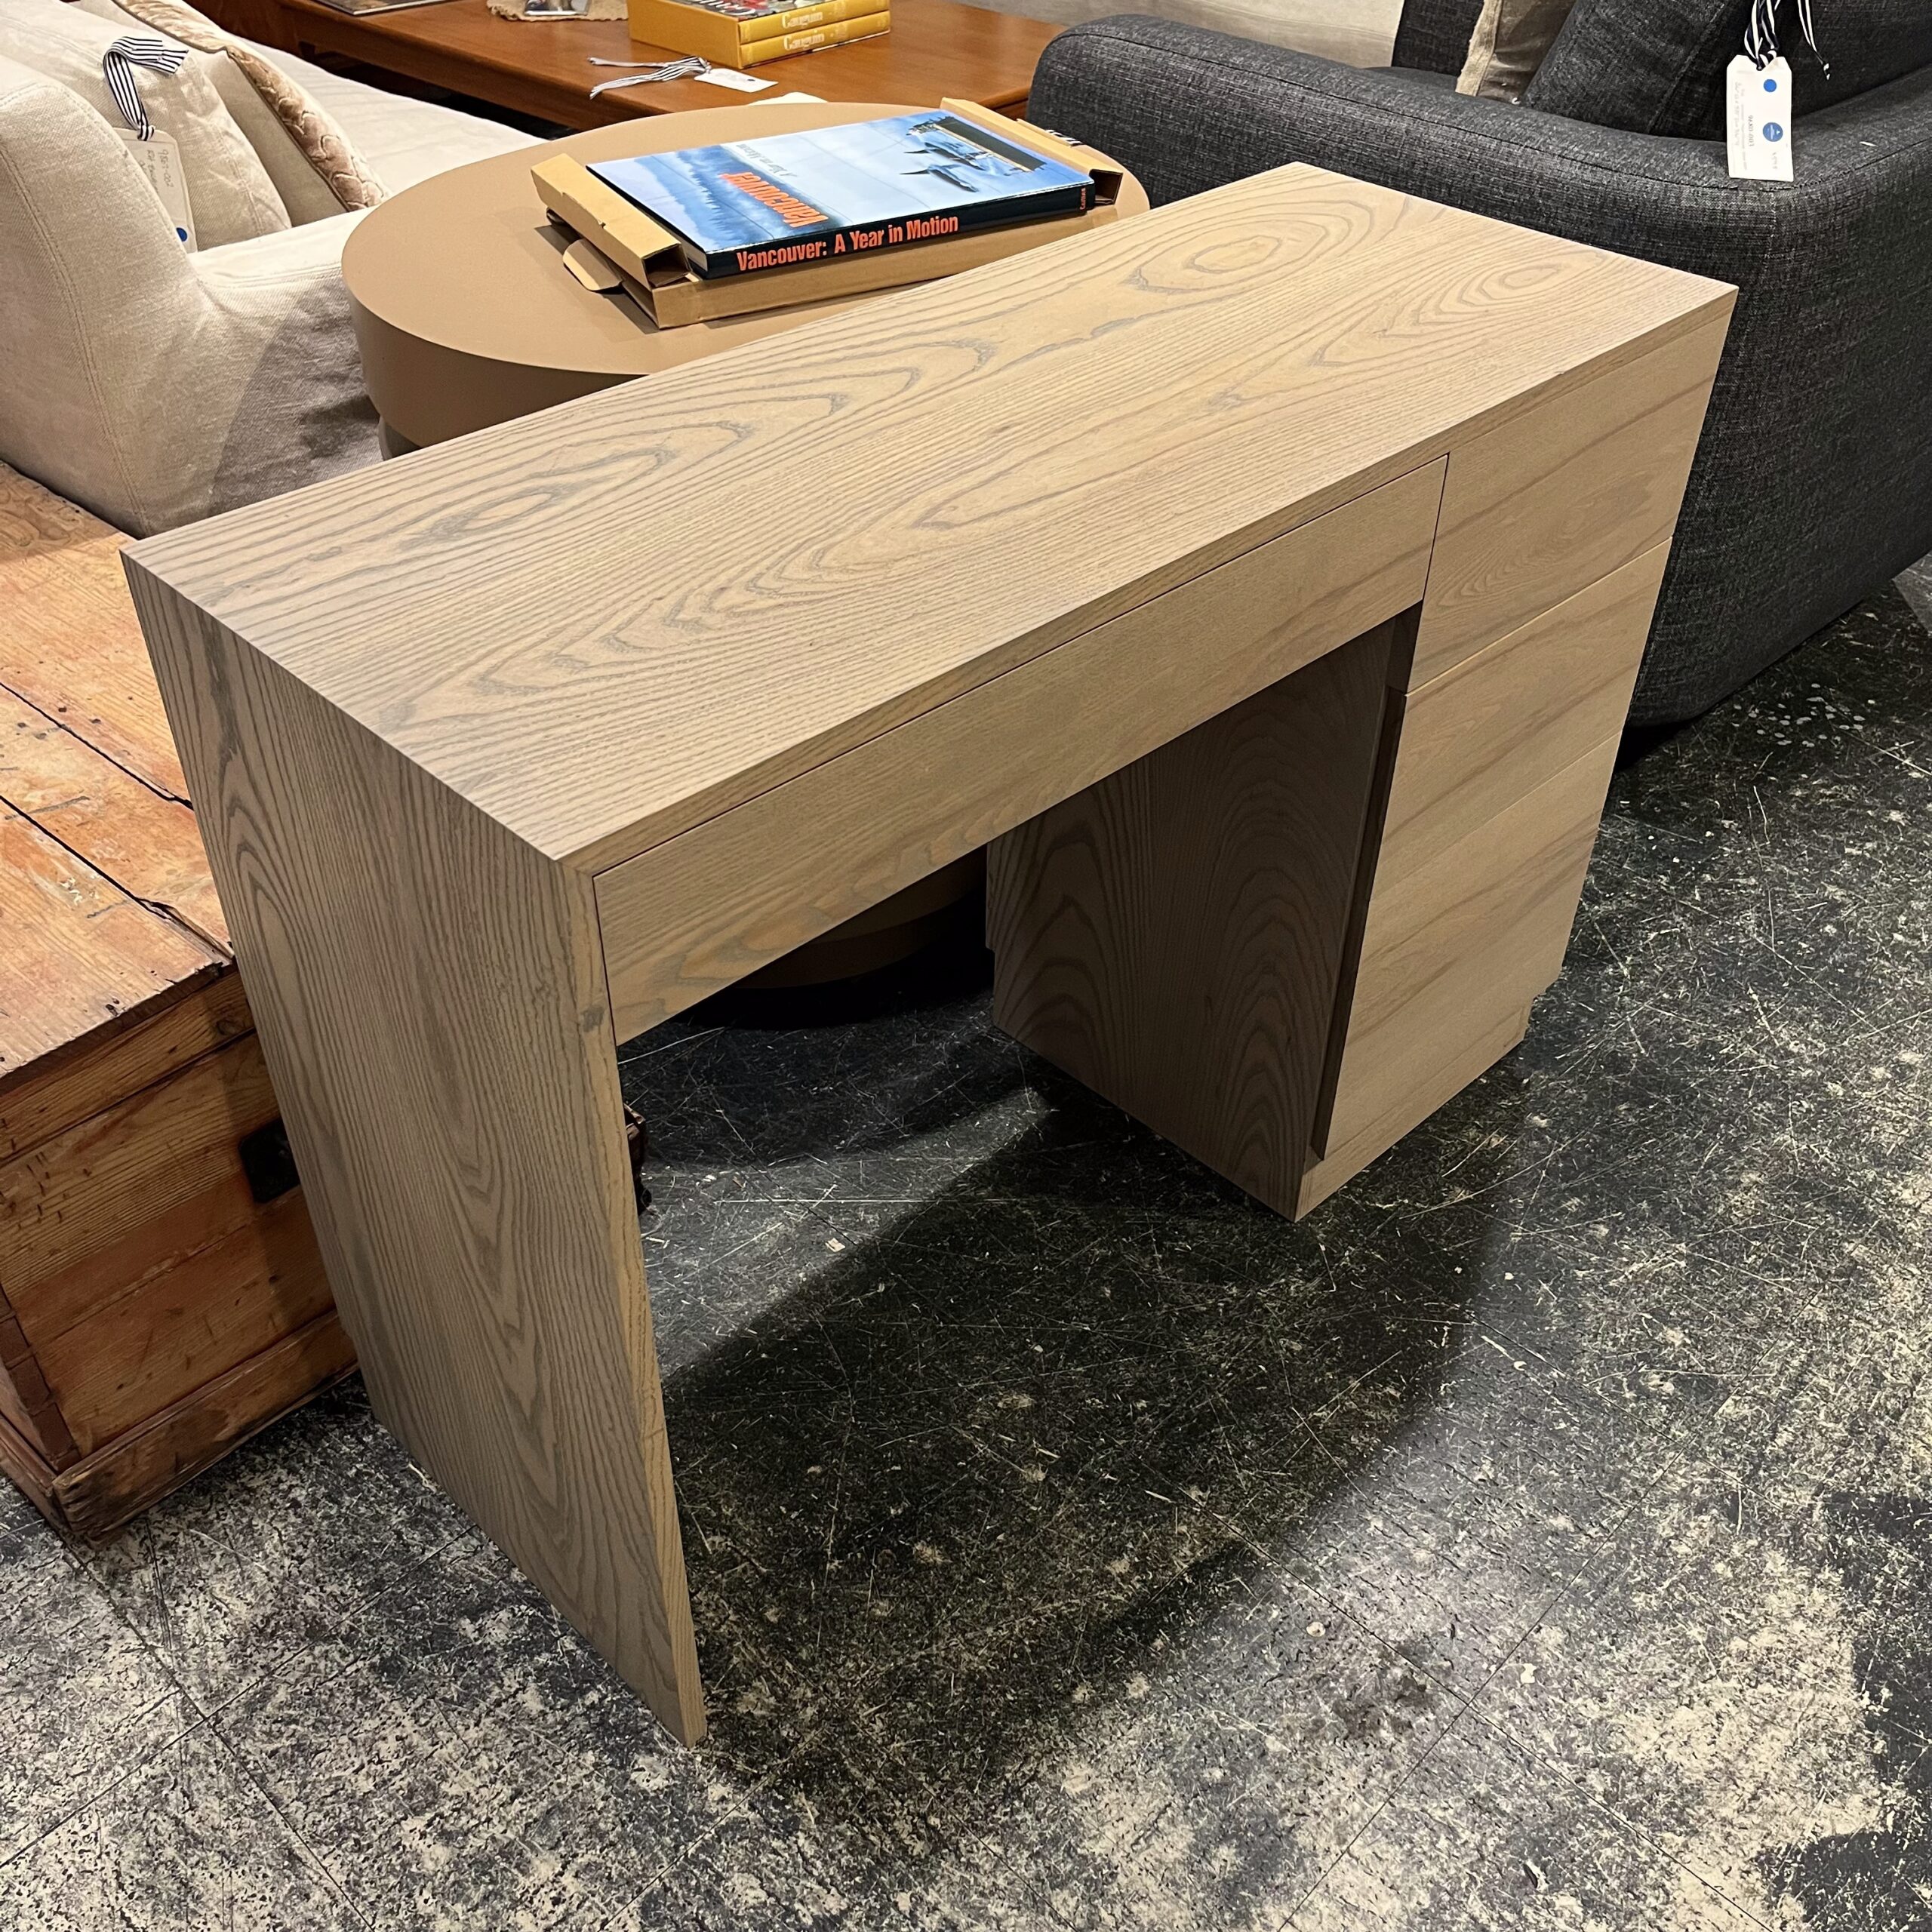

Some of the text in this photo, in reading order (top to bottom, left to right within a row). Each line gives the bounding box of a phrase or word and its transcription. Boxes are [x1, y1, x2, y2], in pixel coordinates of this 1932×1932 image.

[718, 171, 829, 228] Vancouver
[736, 215, 958, 271] Vancouver: A Year in Motion
